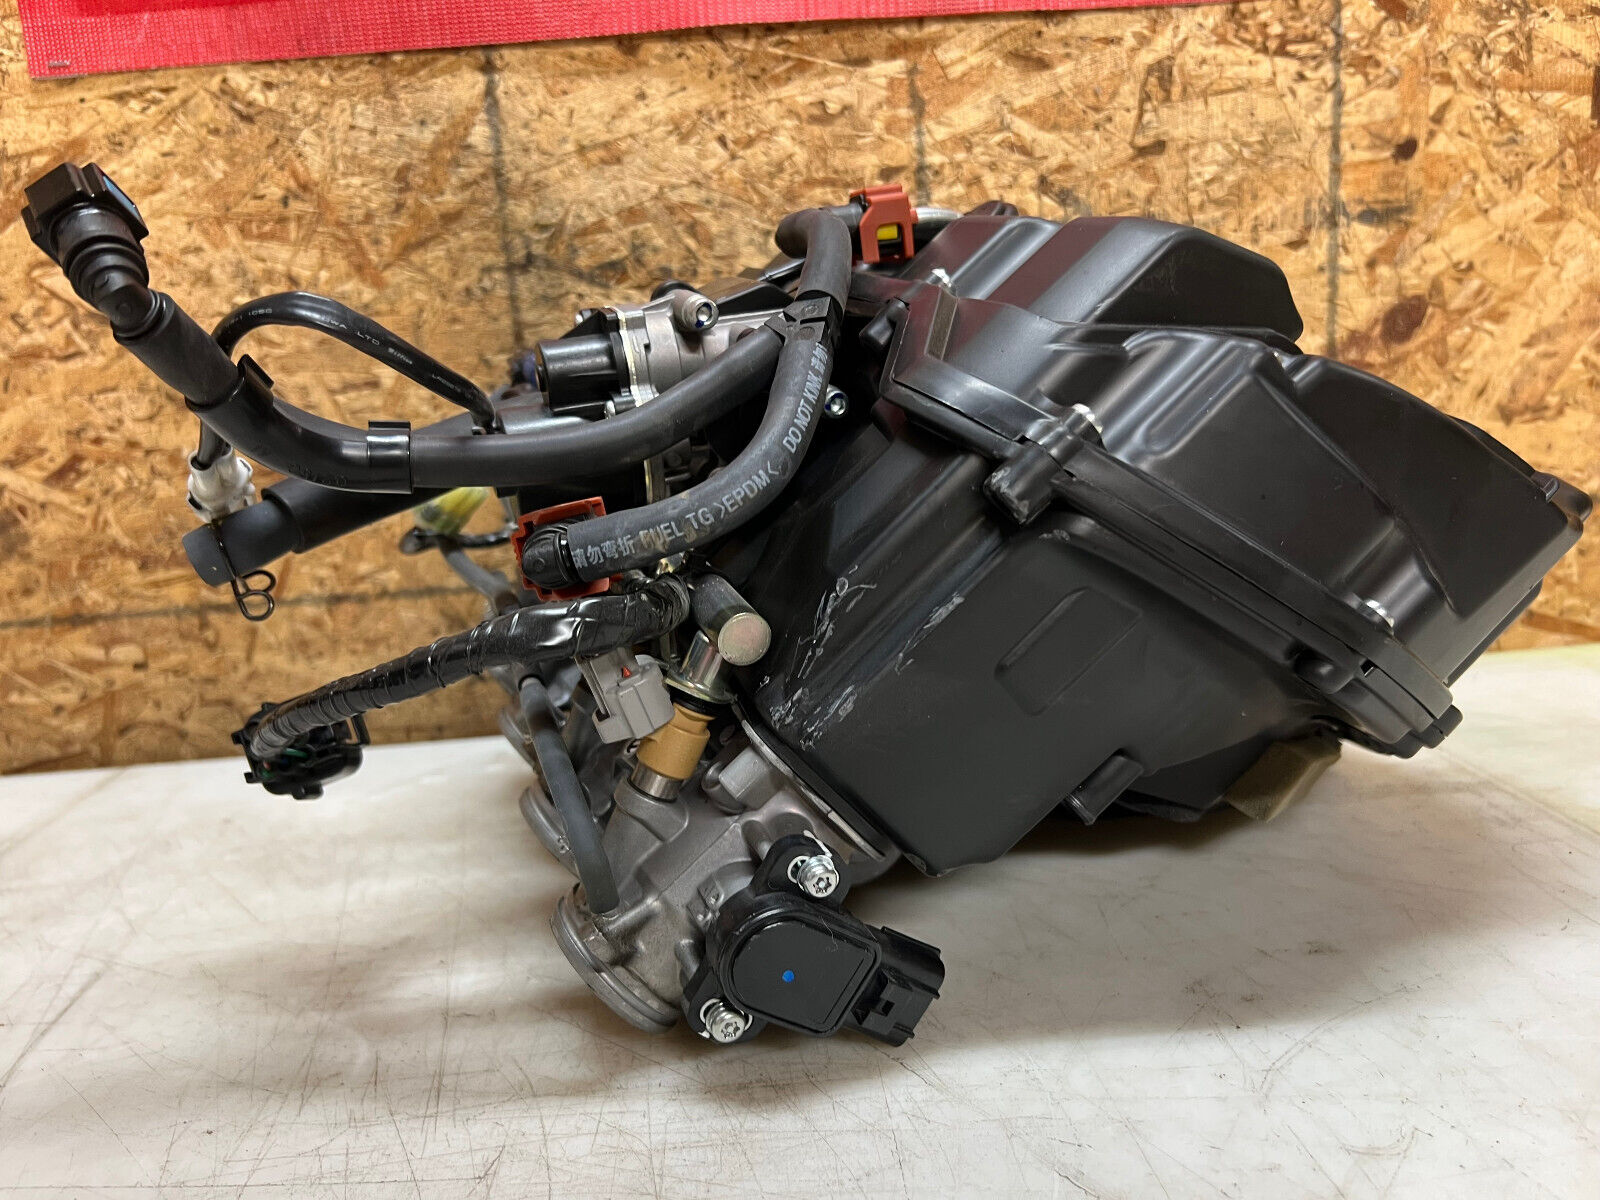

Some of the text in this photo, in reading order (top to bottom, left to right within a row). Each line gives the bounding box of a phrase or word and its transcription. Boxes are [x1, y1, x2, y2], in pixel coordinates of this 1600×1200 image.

[803, 370, 823, 404] KINK
[793, 398, 814, 432] NOT
[782, 426, 803, 454] DO
[685, 507, 714, 530] TG
